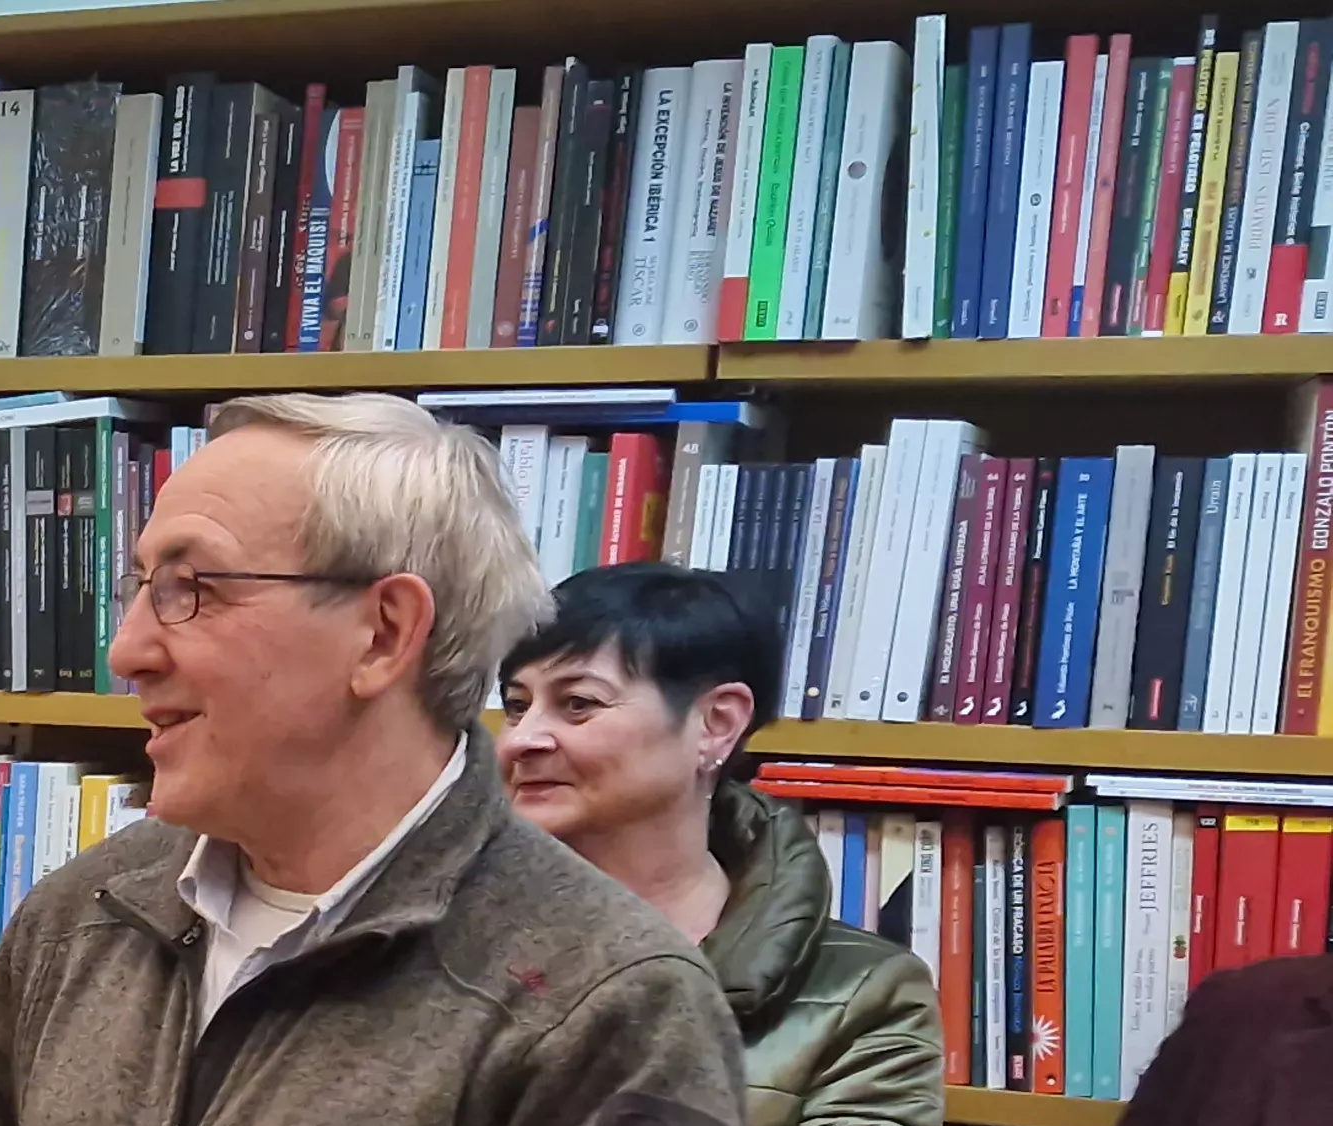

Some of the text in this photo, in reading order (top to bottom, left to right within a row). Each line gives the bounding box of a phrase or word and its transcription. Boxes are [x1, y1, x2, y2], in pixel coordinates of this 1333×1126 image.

[657, 88, 673, 106] LA
[722, 82, 732, 92] LA
[717, 94, 731, 140] INVENCIÓN
[649, 108, 671, 179] EXCEPCIÓN
[715, 142, 725, 154] DE
[643, 182, 663, 232] IBÉRICA
[706, 199, 719, 237] NAZARET
[303, 220, 327, 330] ¡VIVA EL MAQUIS!
[1216, 254, 1232, 305] LAWRENCE
[1224, 205, 1238, 241] KRAUSS
[628, 255, 647, 307] TISCAR
[520, 438, 535, 478] Pablo
[1074, 516, 1086, 527] EL
[1076, 493, 1088, 515] ARTE
[1312, 480, 1333, 549] GONZALO
[1069, 536, 1083, 576] MONTAÑA
[940, 518, 969, 683] EL HOLOCAUSTO, UNA GUÍA ILUSTRADA
[1067, 578, 1078, 589] LA
[1297, 558, 1326, 698] EL FRANQUISMO
[1012, 827, 1023, 953] CRÓNICA DE UN FRACASO
[1140, 821, 1159, 913] JEFFRIES
[1036, 860, 1056, 993] LA PALABRA EXACTA
